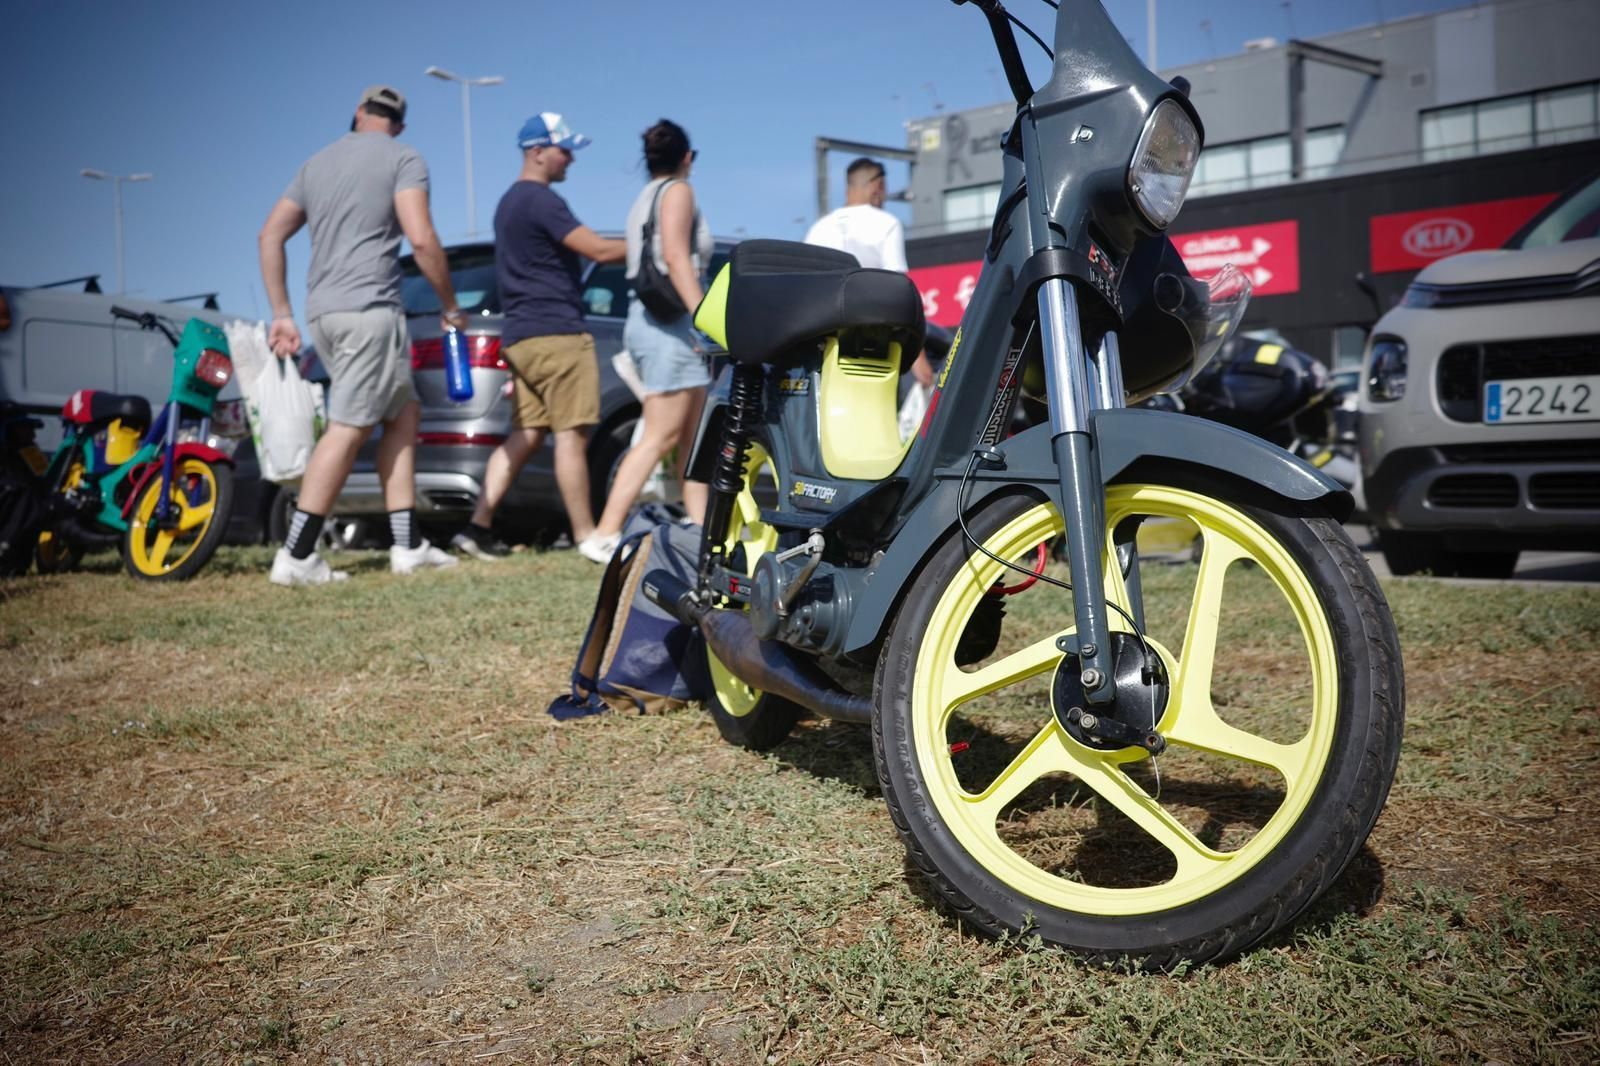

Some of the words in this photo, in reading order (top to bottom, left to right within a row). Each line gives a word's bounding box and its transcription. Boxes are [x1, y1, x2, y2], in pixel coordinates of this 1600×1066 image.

[1415, 225, 1462, 249] KIA
[1506, 384, 1591, 416] 2242
[895, 708, 926, 811] DUNLOP
